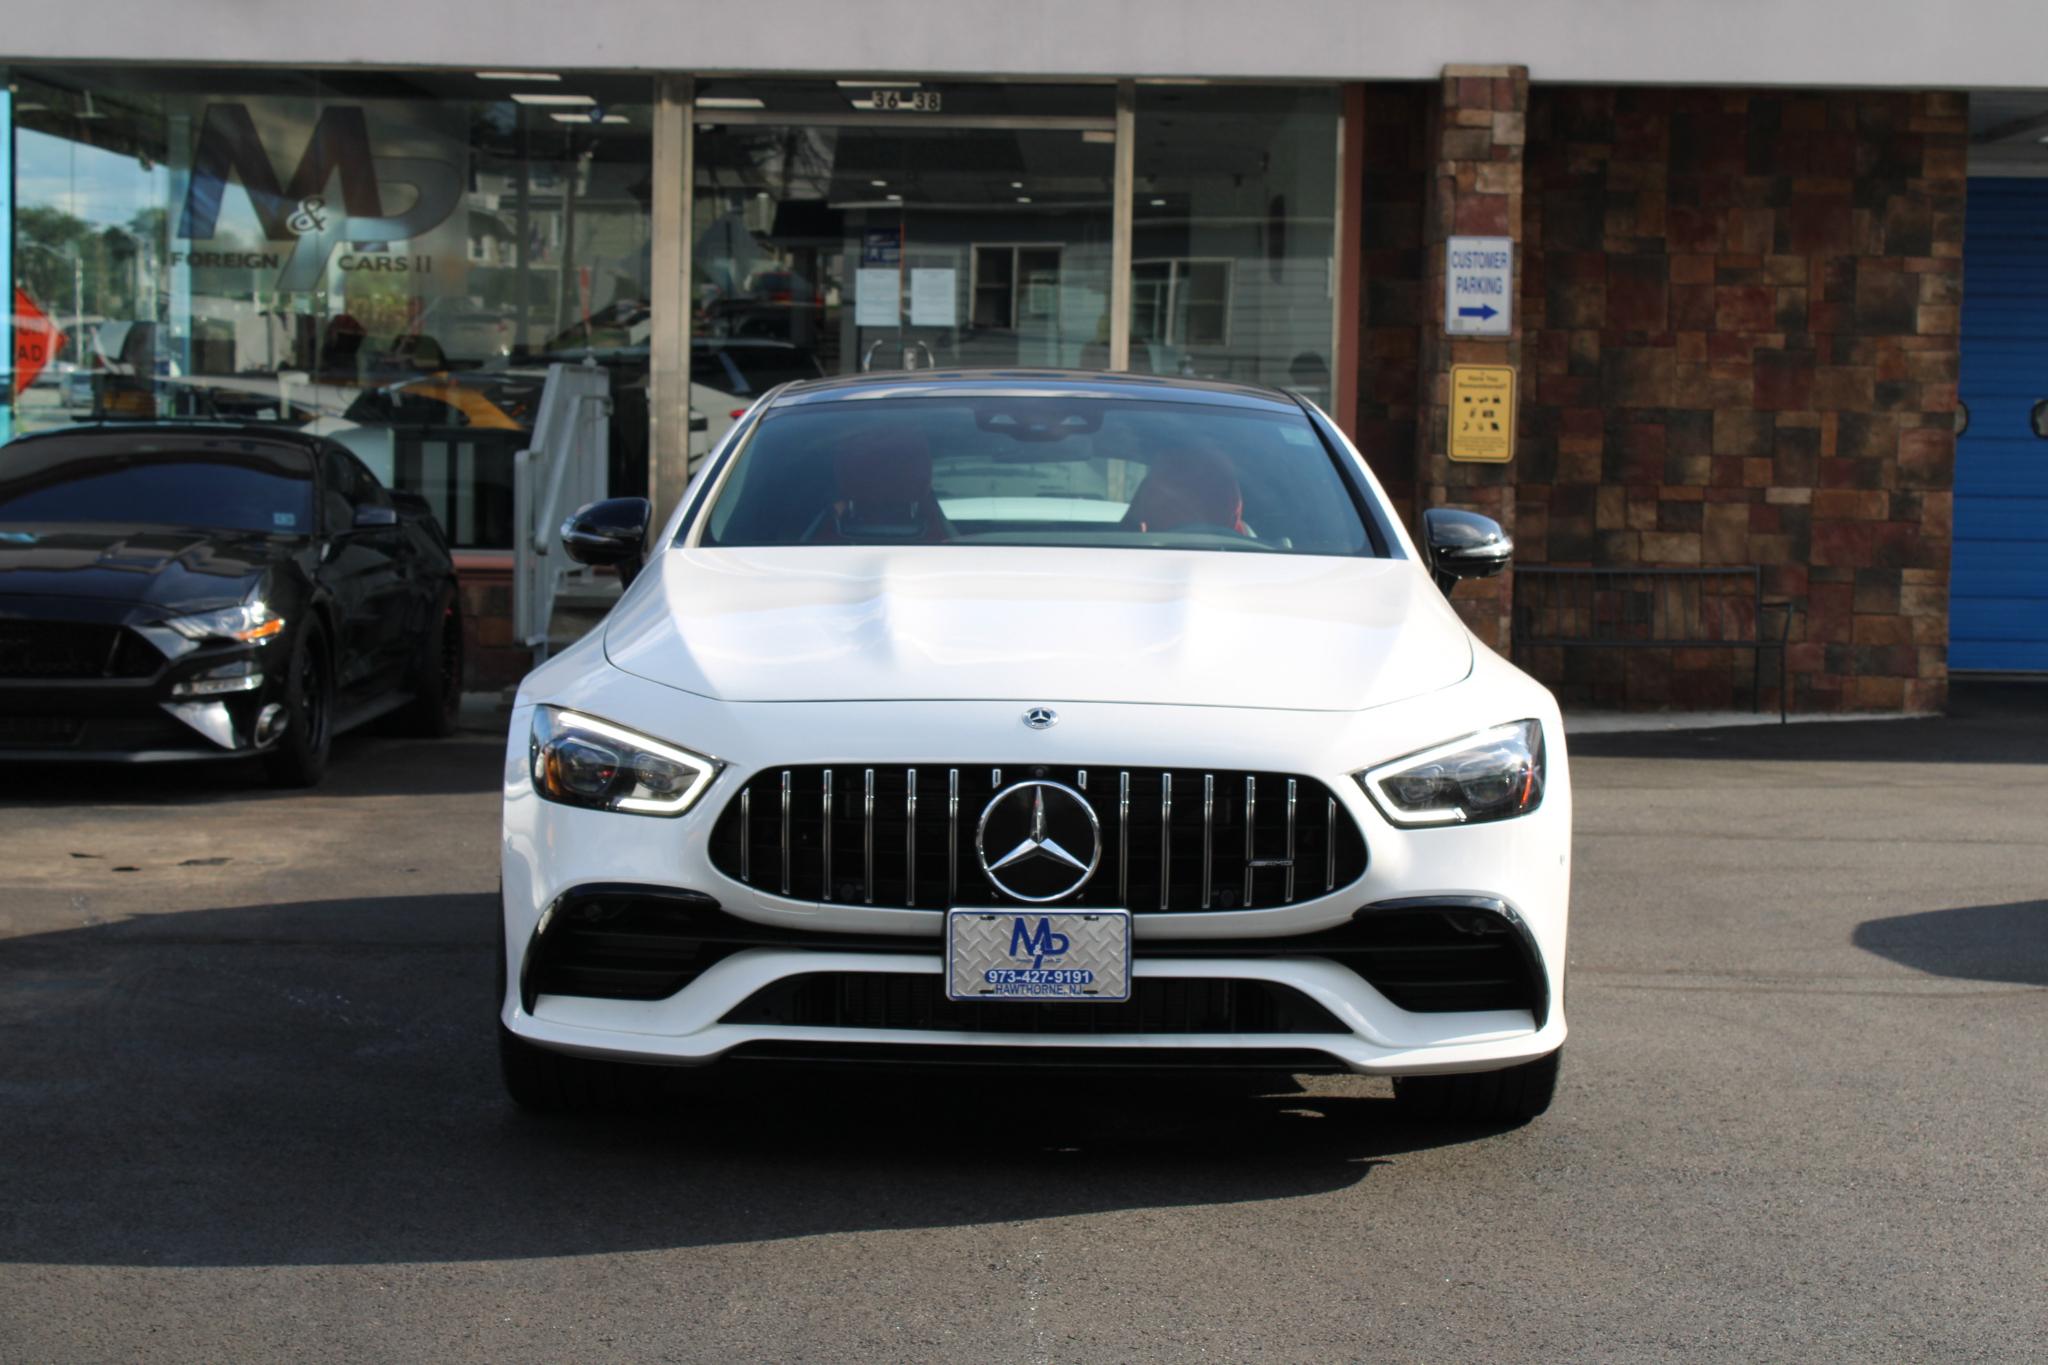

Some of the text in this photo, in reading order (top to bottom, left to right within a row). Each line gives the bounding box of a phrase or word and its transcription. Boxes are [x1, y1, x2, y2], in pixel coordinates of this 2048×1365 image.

[874, 92, 938, 110] 36 38
[171, 252, 279, 269] FOREIGN
[338, 255, 409, 272] CARS
[1452, 251, 1508, 269] CUSTOMER
[1456, 277, 1503, 294] PARKING
[988, 970, 1090, 983] 973-427-9191
[1069, 984, 1082, 994] NJ
